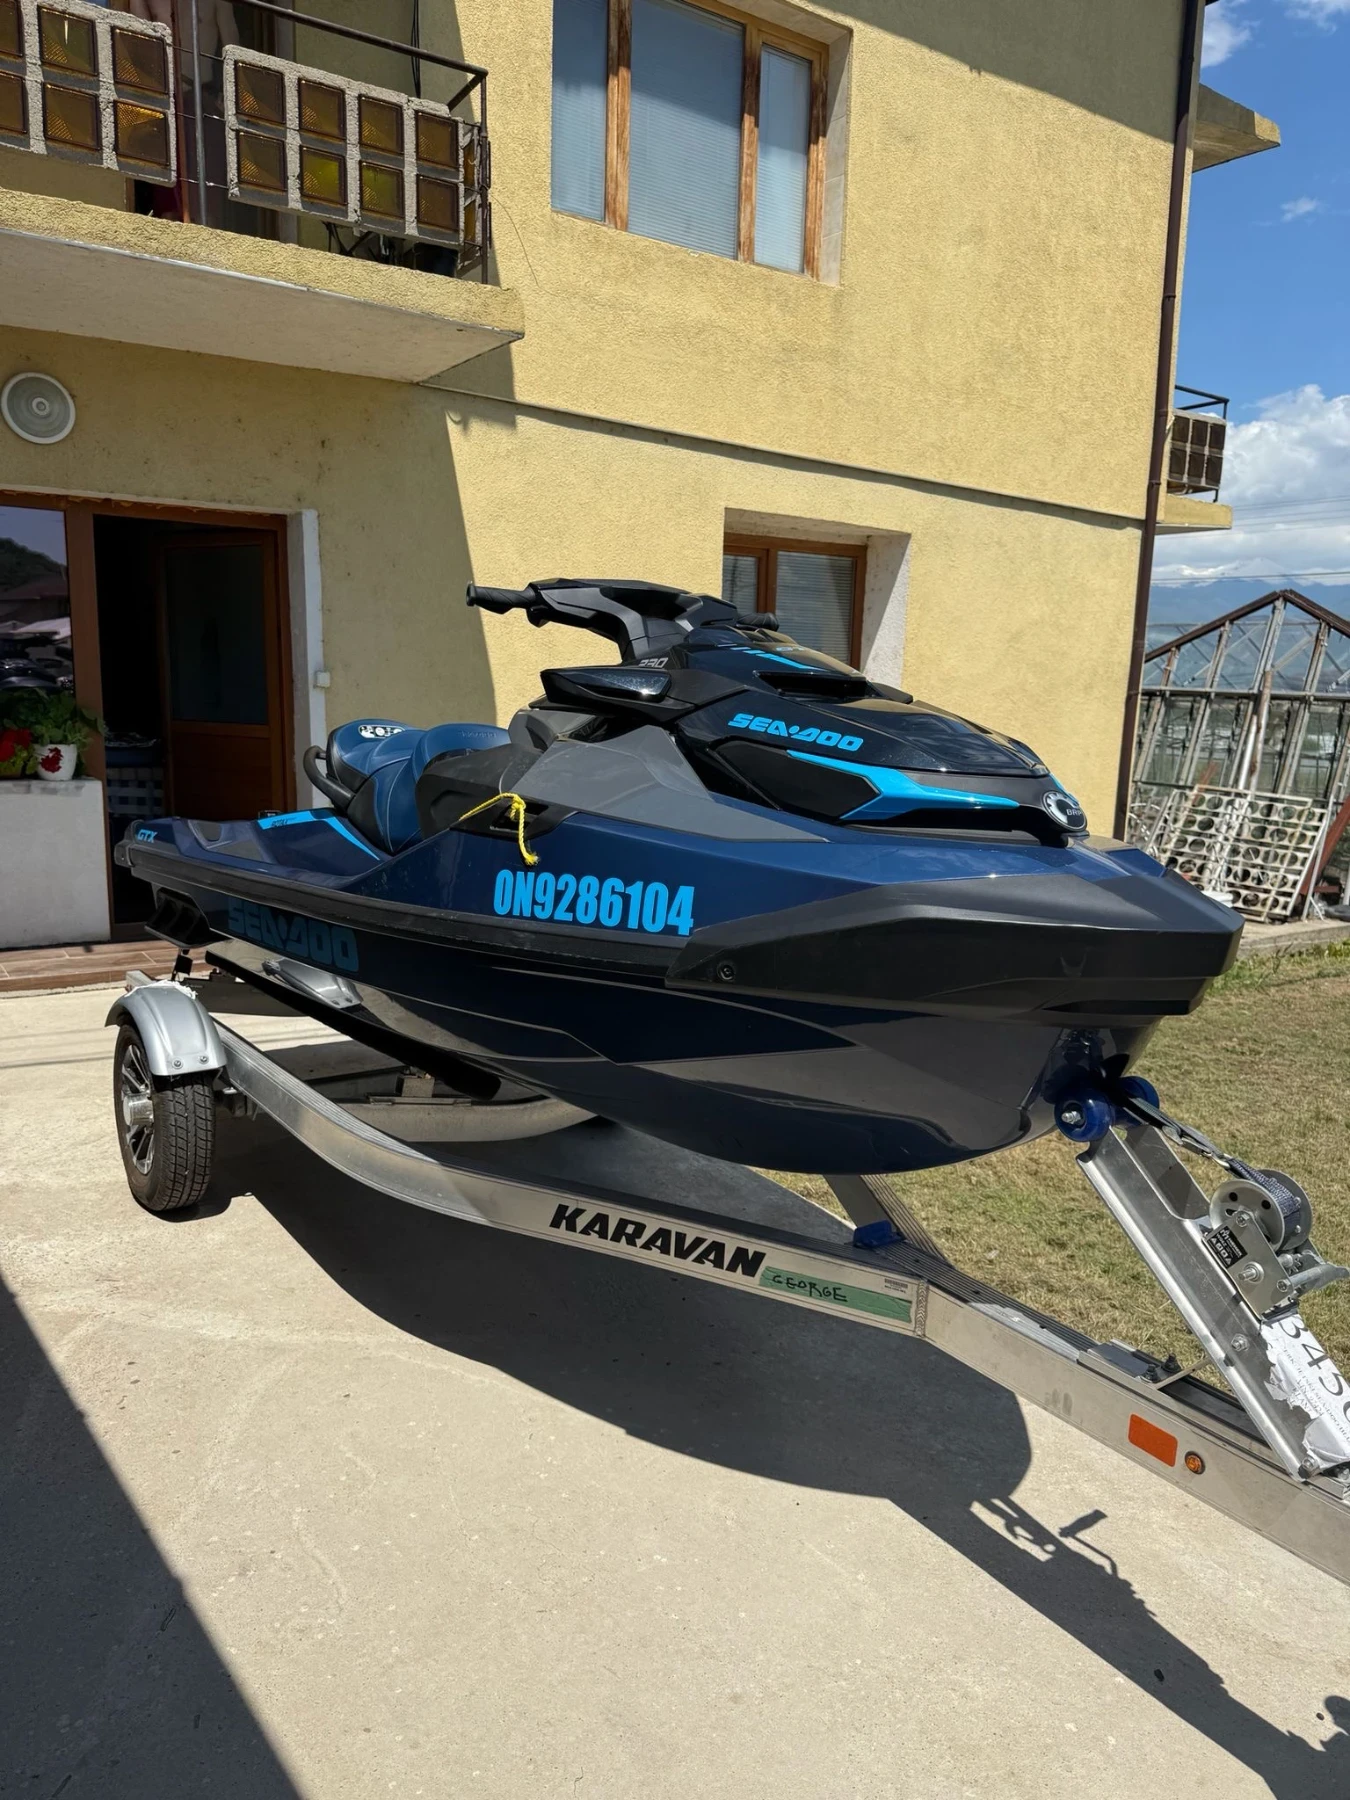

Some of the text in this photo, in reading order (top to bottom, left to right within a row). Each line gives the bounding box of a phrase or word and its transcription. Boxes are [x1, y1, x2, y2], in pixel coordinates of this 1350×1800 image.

[638, 658, 668, 668] 230
[138, 829, 158, 844] GTX
[549, 1204, 766, 1278] KARAVAN
[772, 1275, 848, 1302] GEORGE
